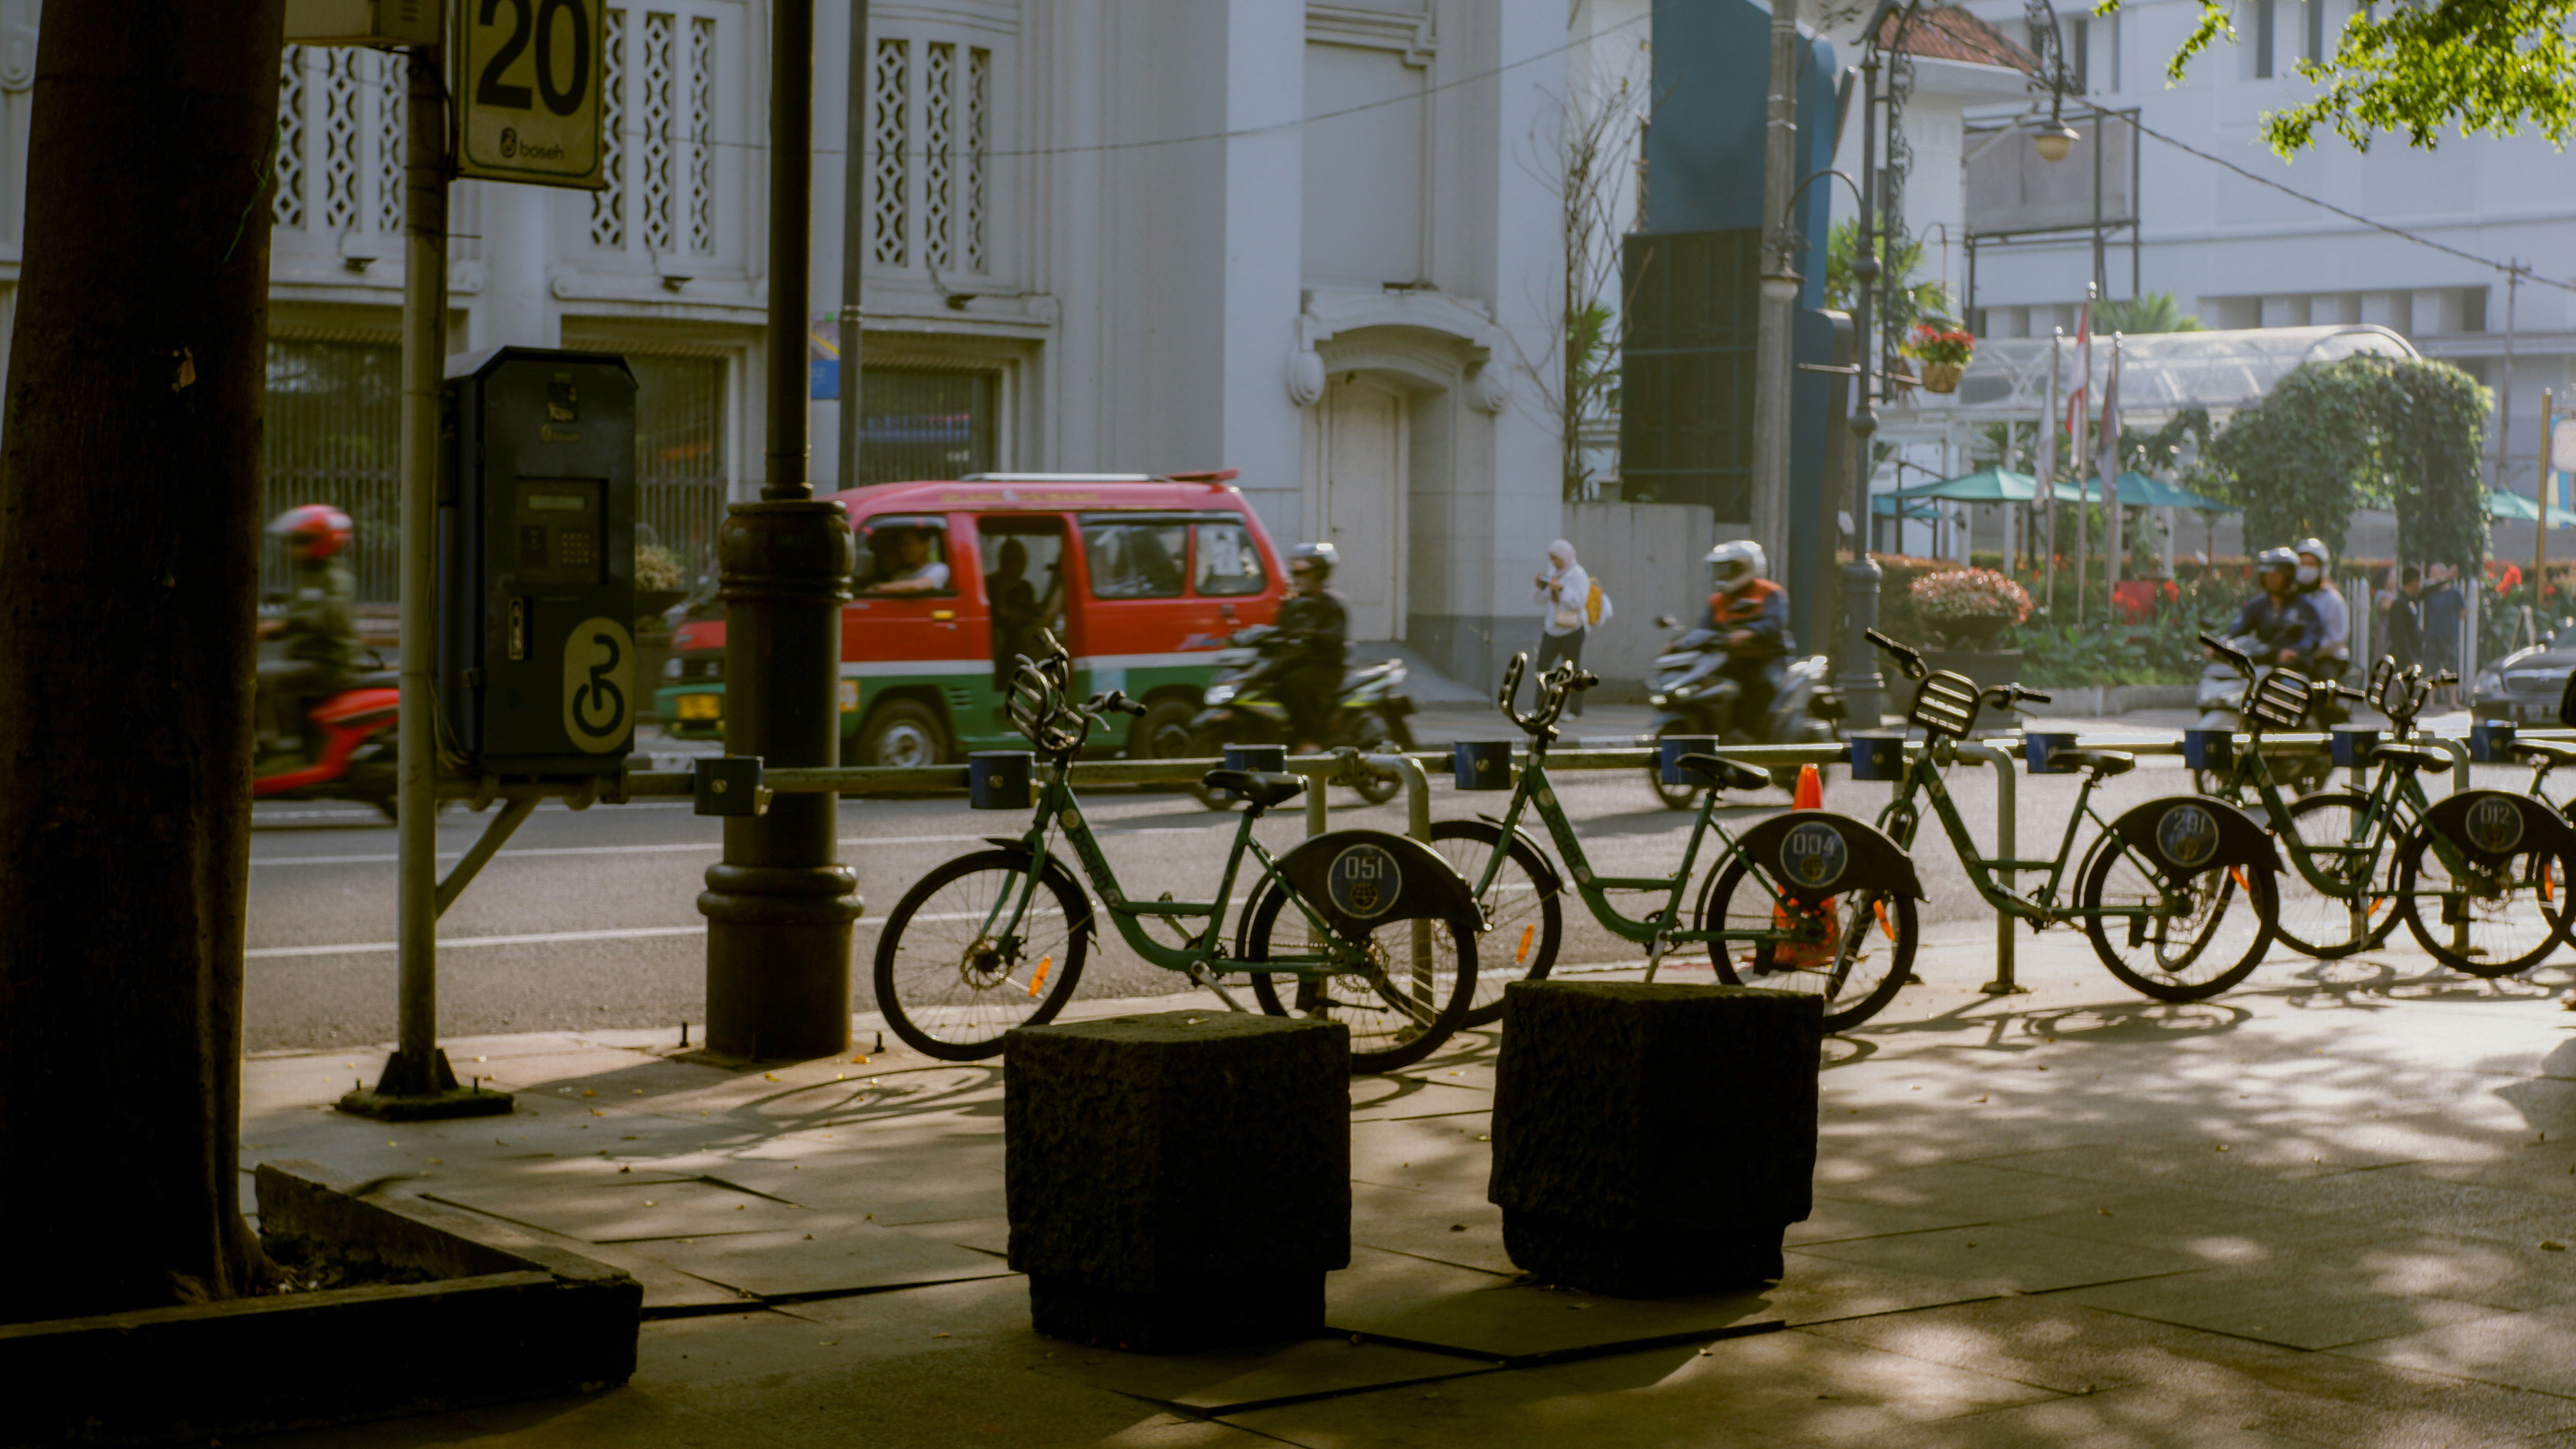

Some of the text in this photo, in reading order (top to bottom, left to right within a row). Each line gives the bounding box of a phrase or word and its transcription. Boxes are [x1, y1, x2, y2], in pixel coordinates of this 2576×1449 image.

[477, 0, 589, 116] 20
[1072, 825, 1111, 890] boseh
[1793, 833, 1835, 855] 004
[1345, 856, 1383, 879] 051
